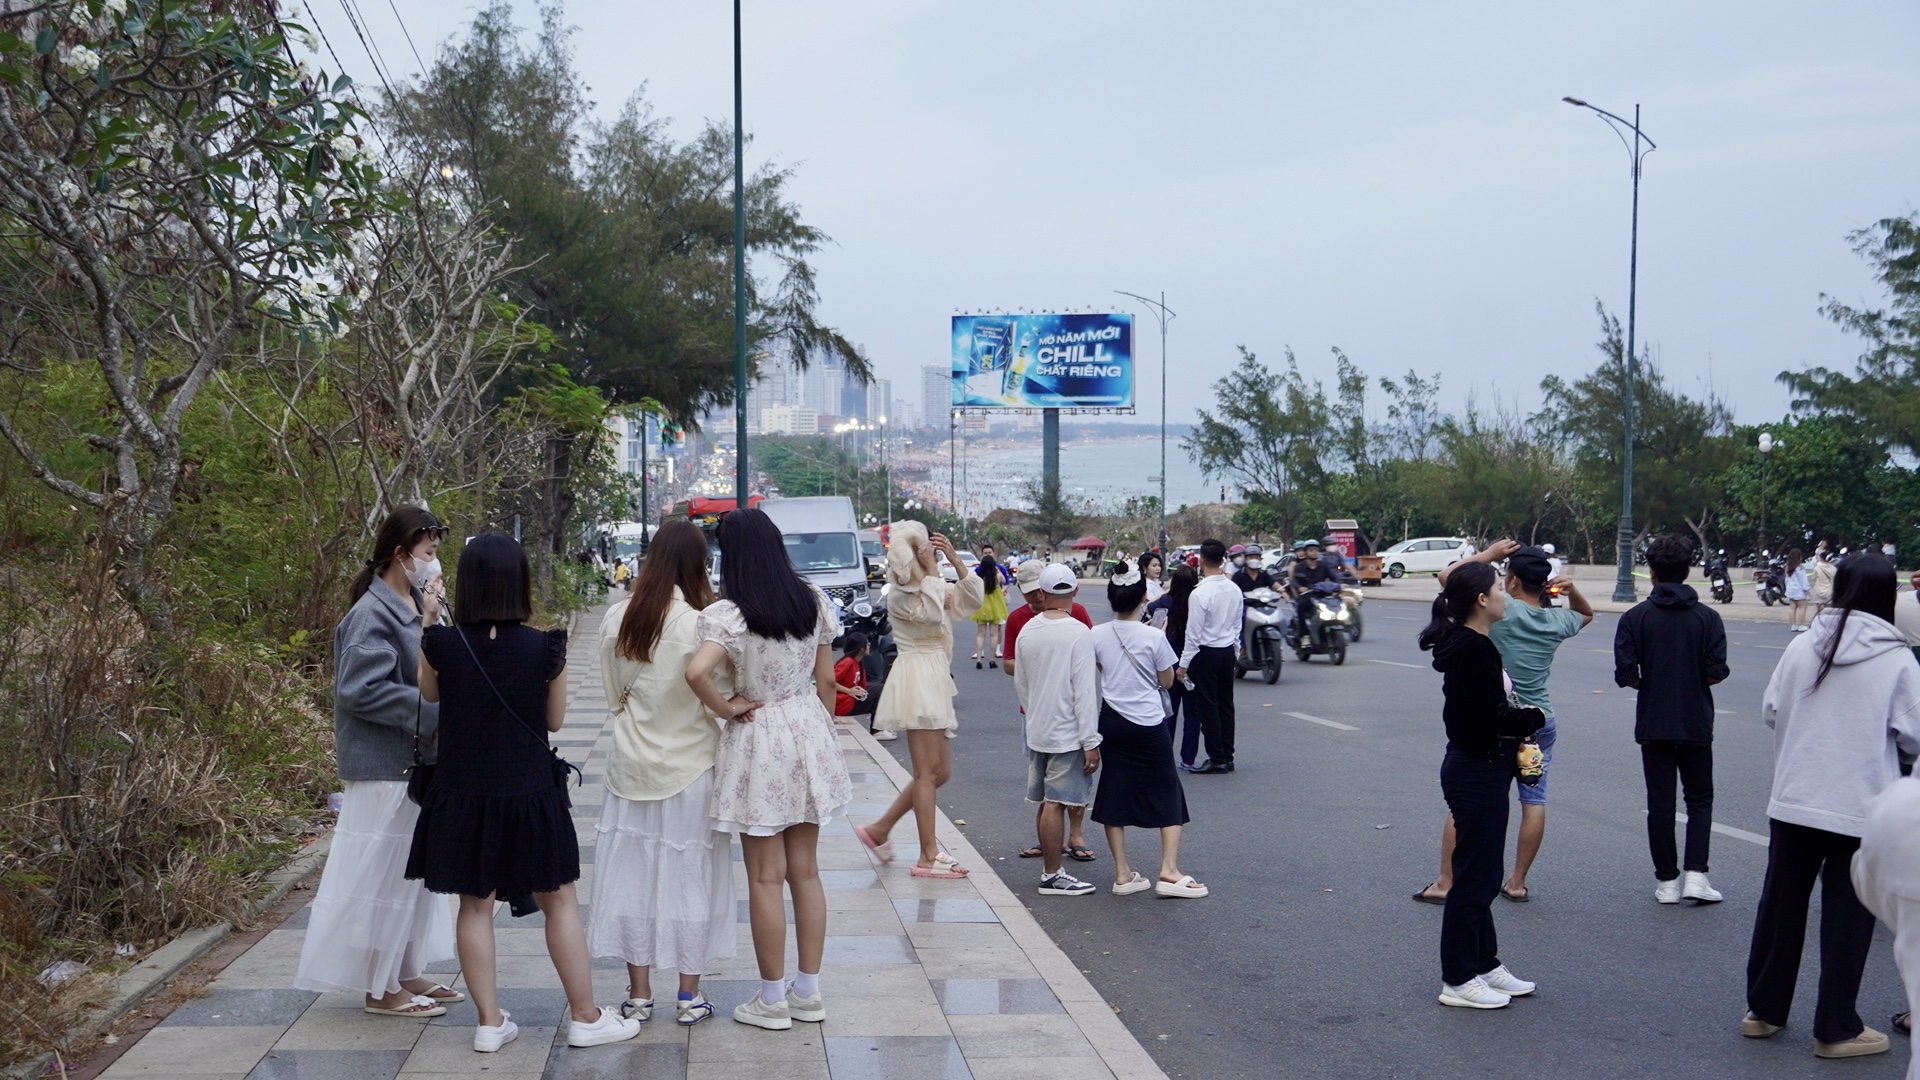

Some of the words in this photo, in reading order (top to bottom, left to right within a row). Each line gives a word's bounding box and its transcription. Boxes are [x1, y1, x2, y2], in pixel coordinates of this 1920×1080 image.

[1057, 332, 1086, 344] NĂM
[1088, 326, 1121, 341] MỚI
[1038, 343, 1113, 364] CHILL
[1069, 364, 1122, 378] RIÊNG
